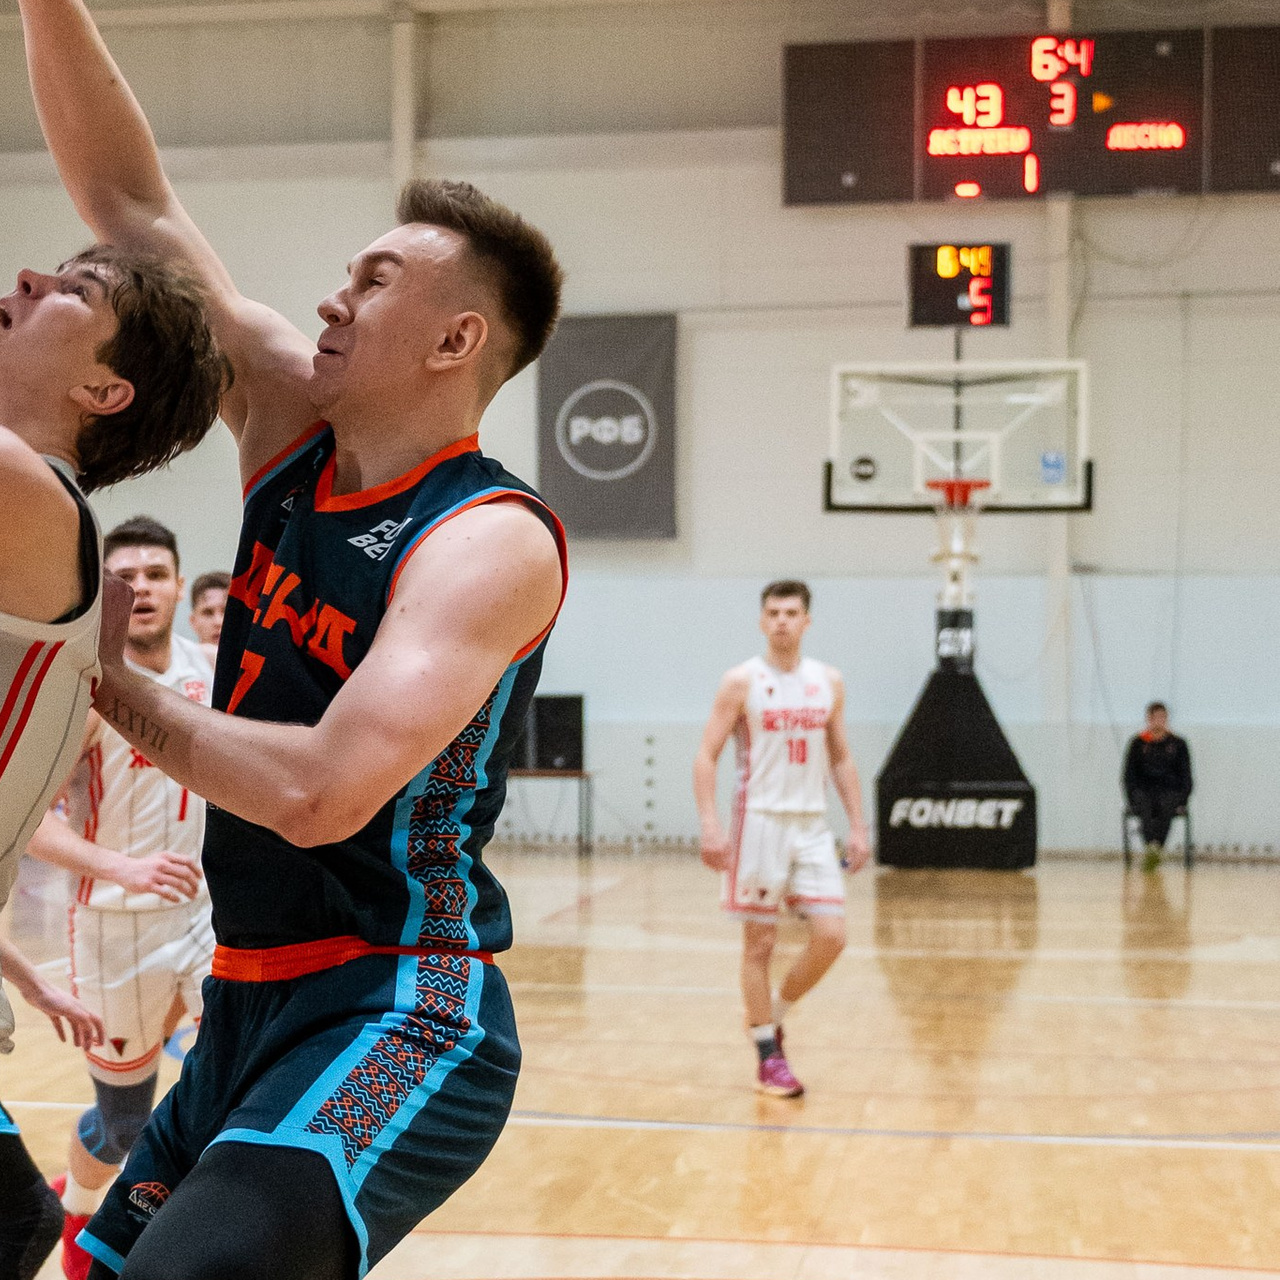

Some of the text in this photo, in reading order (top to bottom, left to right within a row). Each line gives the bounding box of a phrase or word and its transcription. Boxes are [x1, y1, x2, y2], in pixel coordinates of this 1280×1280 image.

[946, 82, 1003, 128] 43
[1049, 80, 1076, 126] 3
[570, 415, 643, 445] РФБ
[889, 797, 1024, 830] FONBET
